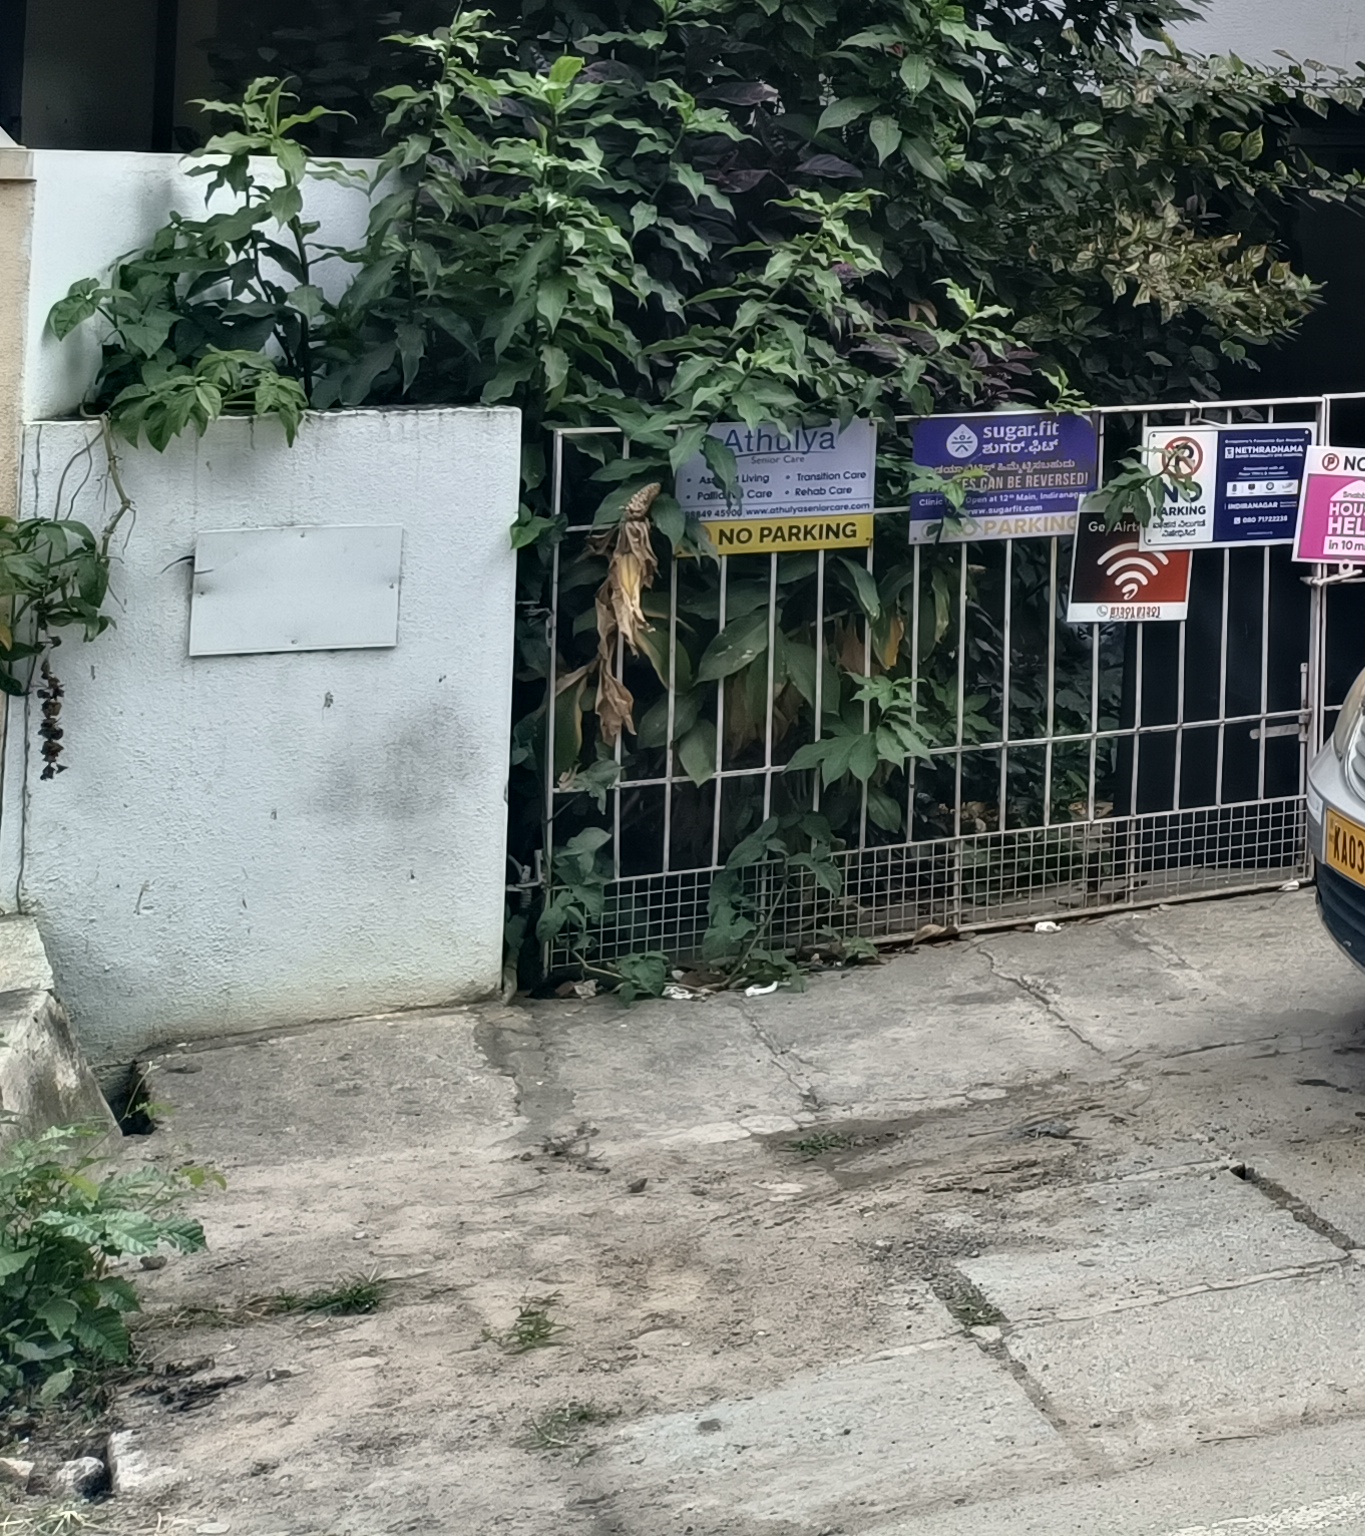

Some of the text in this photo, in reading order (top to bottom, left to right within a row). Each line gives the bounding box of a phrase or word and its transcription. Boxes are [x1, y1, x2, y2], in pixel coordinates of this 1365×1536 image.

[983, 421, 1060, 441] sugar.fit
[725, 428, 836, 454] Athulya
[1235, 445, 1303, 455] NETHRADHAMA
[751, 455, 805, 465] Senior Care
[741, 473, 770, 485] Living
[796, 470, 867, 482] Transition Care
[980, 476, 1003, 490] CAN
[1007, 475, 1022, 488] BE
[1026, 472, 1088, 487] REVERSED!
[747, 489, 773, 499] Care
[795, 486, 853, 496] Rehab Care
[919, 497, 943, 506] Clinic
[966, 495, 988, 505] Open
[989, 495, 998, 503] at
[983, 515, 1078, 536] PARKING
[1088, 521, 1107, 532] Ge
[719, 522, 857, 546] NO PARKING
[1328, 539, 1339, 550] in
[1342, 540, 1353, 550] 10
